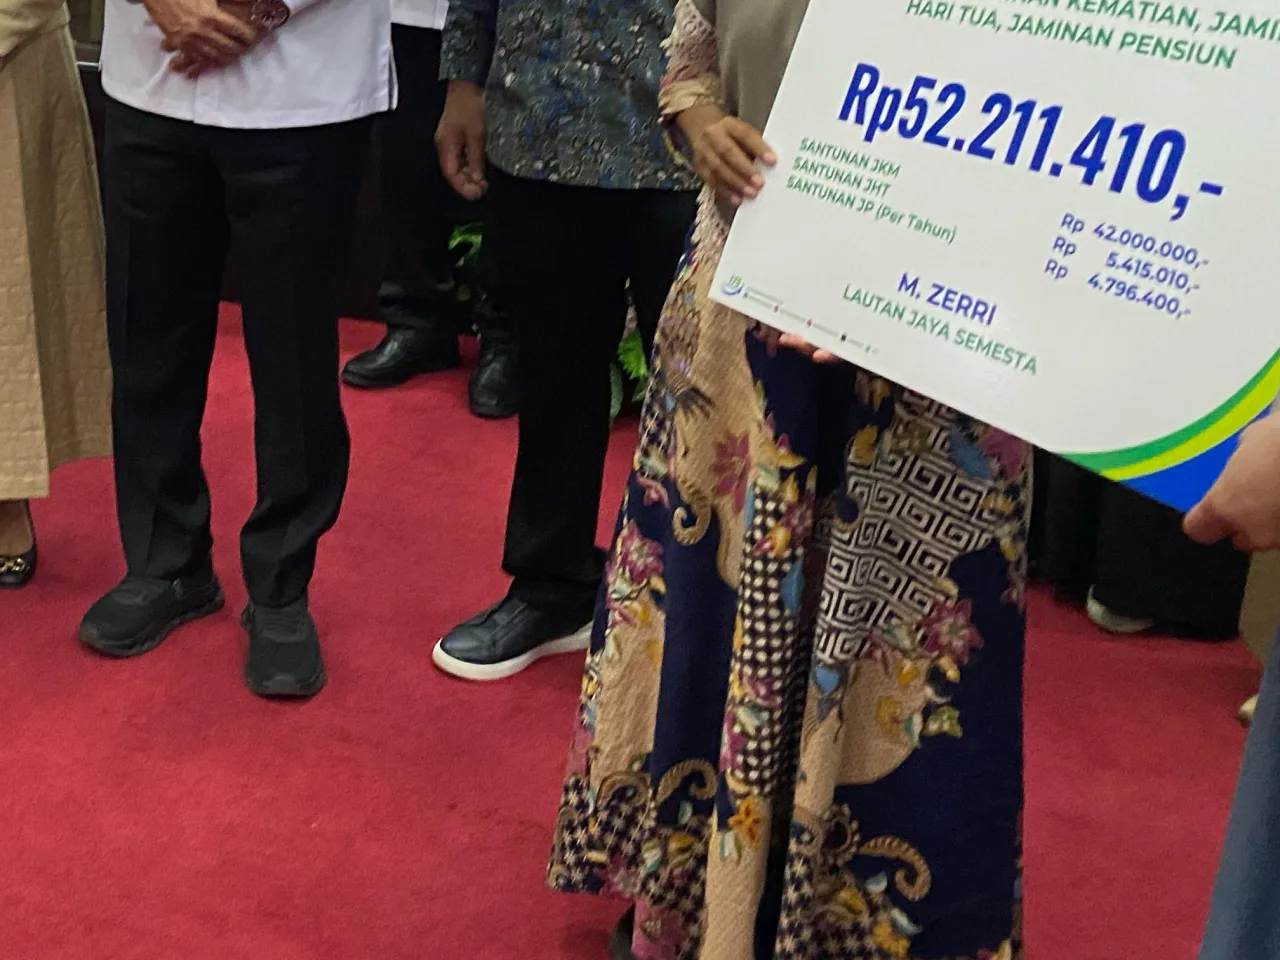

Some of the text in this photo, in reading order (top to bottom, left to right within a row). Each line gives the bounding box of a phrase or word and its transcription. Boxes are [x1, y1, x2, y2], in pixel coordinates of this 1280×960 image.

[959, 4, 1003, 34] TUA,
[1007, 11, 1115, 49] JAMINAN
[1118, 30, 1238, 70] PENSIUN
[1207, 10, 1280, 43] JAMI
[799, 137, 902, 180] SANTUNAN JKM
[837, 62, 1225, 221] Rp52.211.410,-
[792, 156, 892, 199] SANTUNAN JHT
[786, 175, 958, 246] SANTUNAN JP (Per Tahun)
[1052, 235, 1201, 295] Rp 5.415.010,-
[1059, 212, 1210, 270] Rp 42.000.000,-
[896, 271, 998, 327] M. ZERRI
[1044, 258, 1192, 320] Rp 4.796.400,-
[842, 283, 907, 322] LAUTAN
[906, 309, 950, 341] JAYA
[953, 328, 1038, 377] SEMESTA
